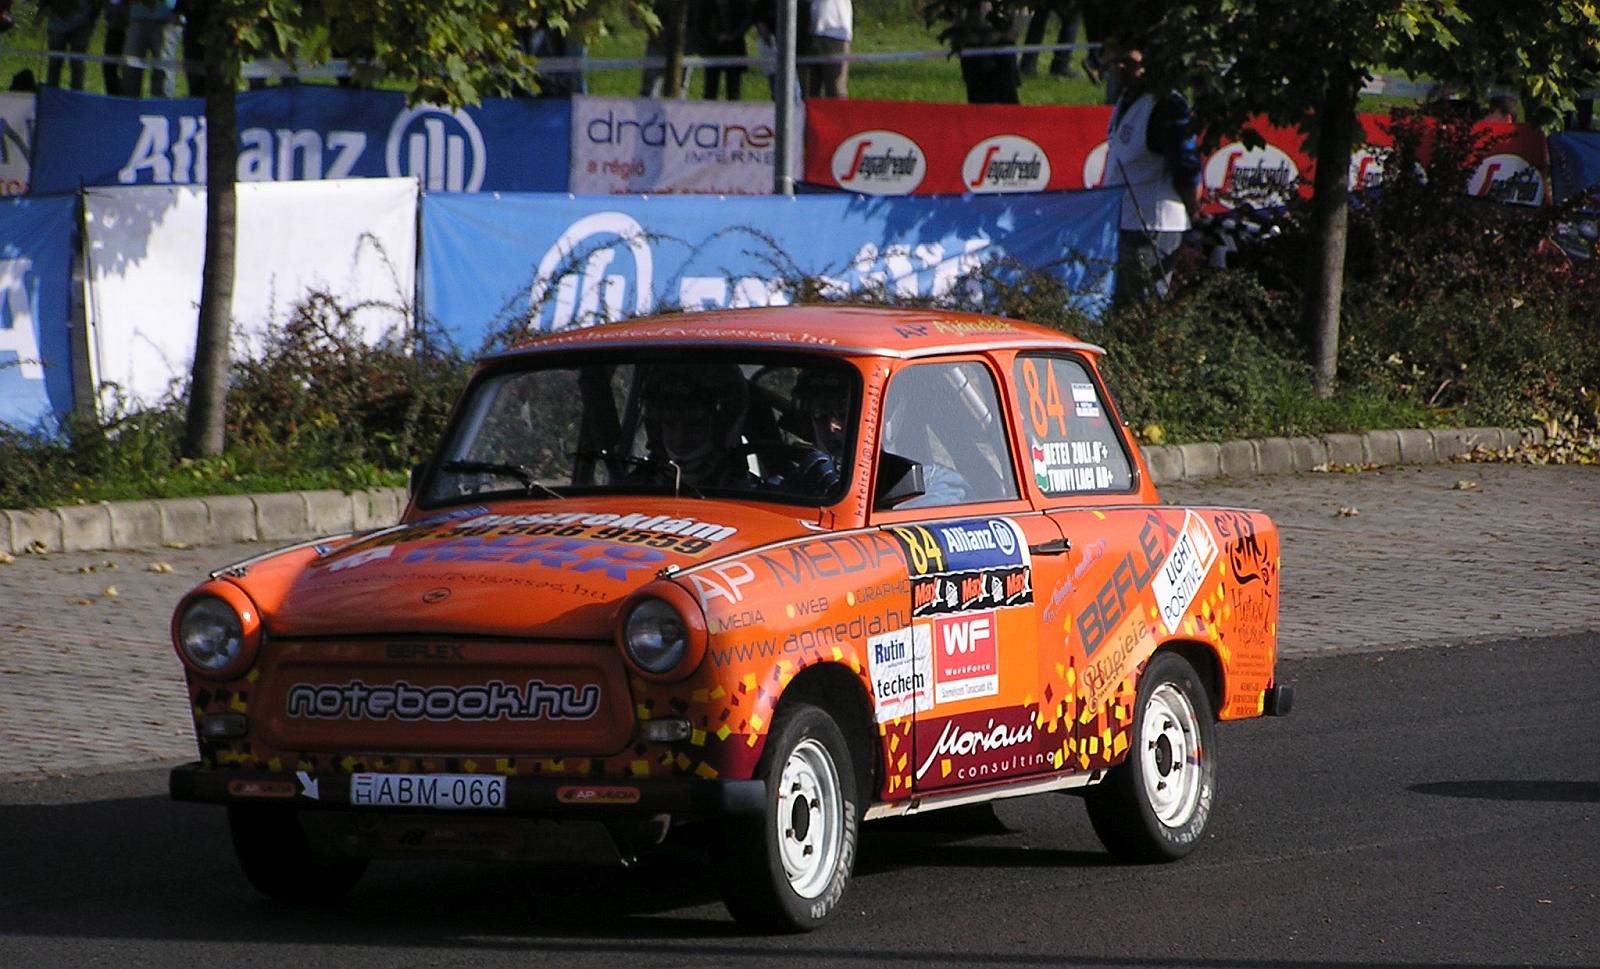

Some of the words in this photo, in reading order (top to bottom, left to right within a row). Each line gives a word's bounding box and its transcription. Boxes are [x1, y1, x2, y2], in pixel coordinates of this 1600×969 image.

[588, 110, 776, 148] drávane
[685, 152, 775, 163] INTERNE
[841, 140, 917, 181] Segafredo
[971, 146, 1041, 187] Segafredo
[1022, 358, 1067, 438] 84
[589, 525, 712, 555] 9559
[893, 525, 944, 575] 84
[941, 526, 997, 554] Allianz
[689, 561, 755, 619] AP
[757, 532, 906, 588] MEDIA
[1165, 534, 1193, 585] LIGHT
[1077, 513, 1181, 658] BEFLEX
[1163, 560, 1202, 621] POSITIVE
[718, 610, 765, 631] MEDIA
[795, 597, 830, 616] WEB
[386, 644, 465, 660] BEFLEX
[711, 608, 912, 668] www.apmedia.hu
[875, 638, 906, 665] Rutin
[943, 618, 990, 656] WF
[877, 672, 925, 699] techem
[944, 662, 991, 677] WorkForce
[287, 679, 600, 721] notebook.hu
[957, 750, 1055, 780] consulting
[378, 777, 501, 806] ABM-066
